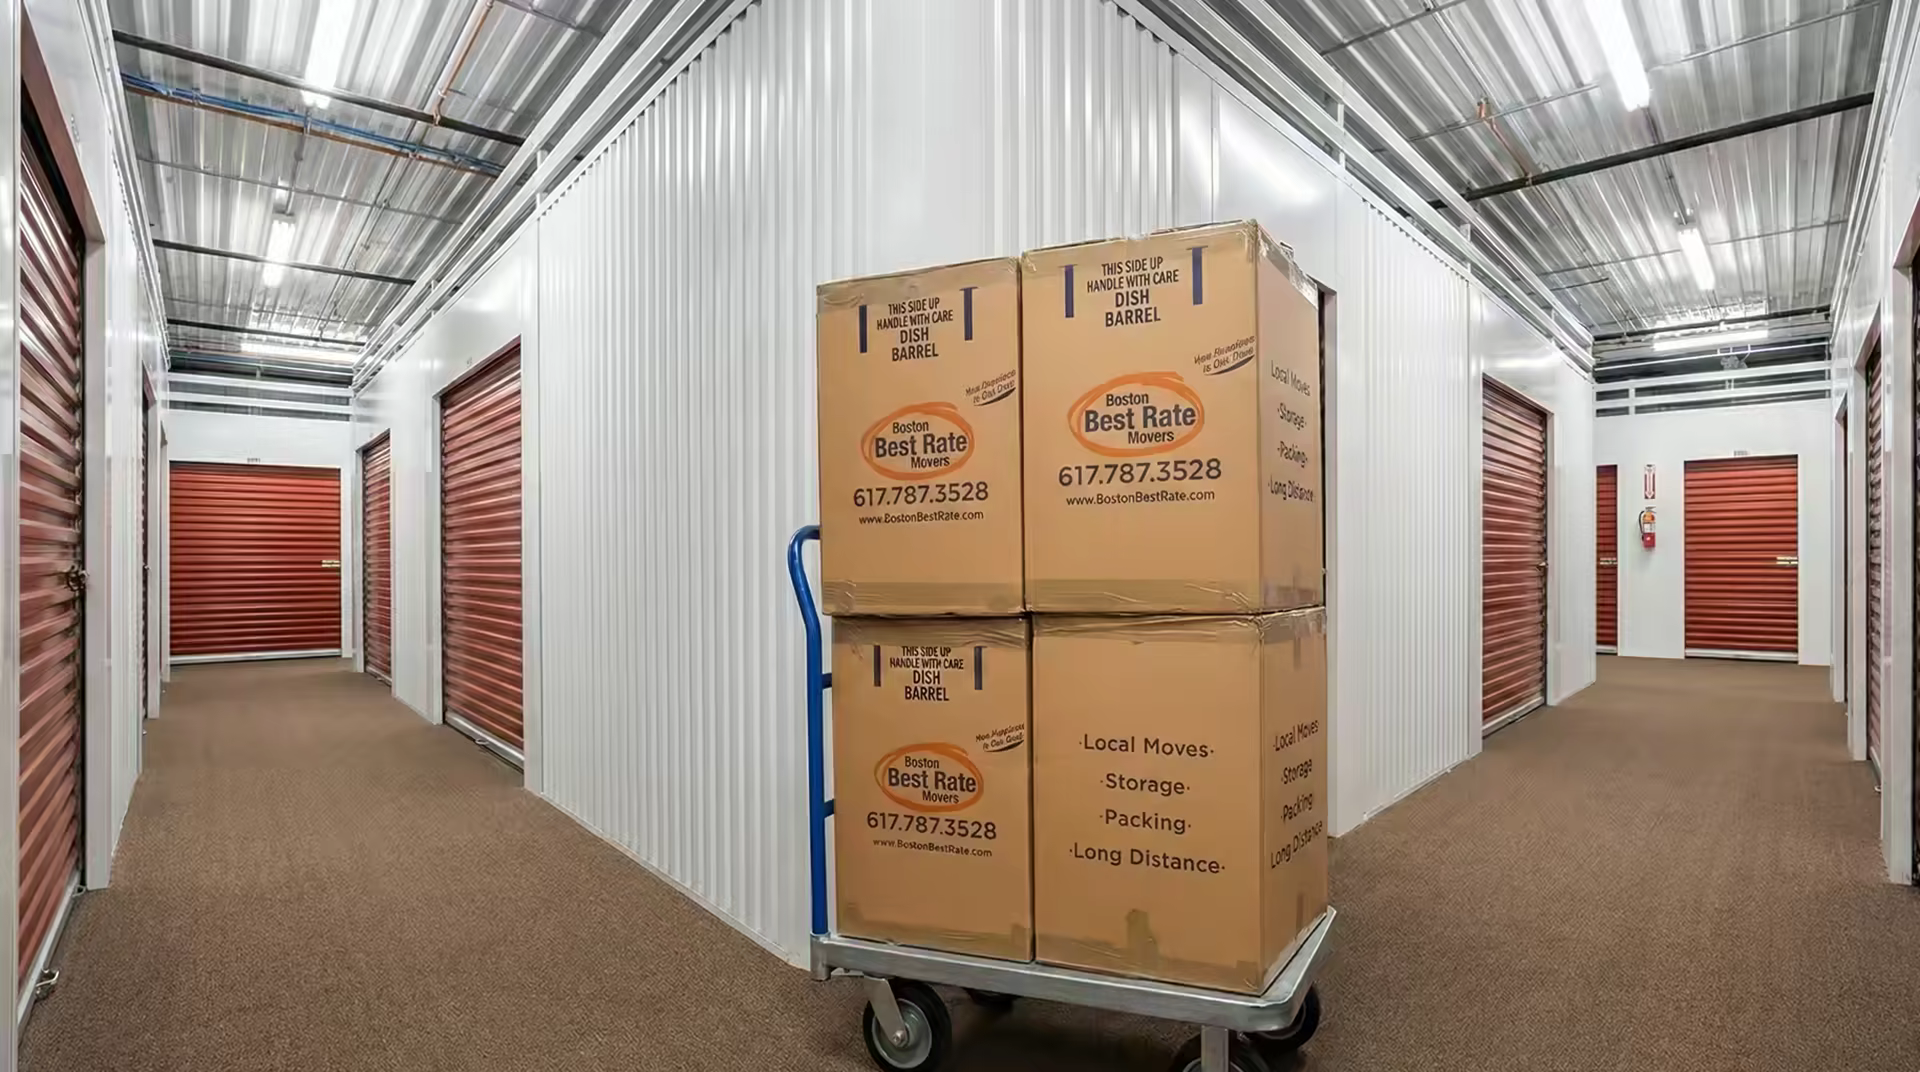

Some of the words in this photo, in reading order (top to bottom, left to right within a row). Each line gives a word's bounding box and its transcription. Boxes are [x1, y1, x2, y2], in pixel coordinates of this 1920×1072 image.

[1101, 261, 1123, 276] THIS
[1125, 258, 1148, 274] SIDE
[1150, 256, 1164, 270] UP
[1087, 277, 1124, 293] HANDLE
[1126, 273, 1150, 288] WITH
[1152, 269, 1179, 285] CARE
[888, 302, 906, 316] THIS
[908, 299, 927, 313] SIDE
[929, 297, 940, 310] UP
[1115, 289, 1150, 308] DISH
[876, 316, 909, 331] HANDLE
[910, 313, 930, 327] WITH
[932, 309, 954, 323] CARE
[1105, 306, 1161, 327] BARREL
[900, 327, 929, 344] DISH
[892, 343, 939, 362] BARREL
[1106, 392, 1149, 407] Boston
[893, 421, 929, 434] Boston
[1084, 408, 1135, 433] Best
[1142, 404, 1196, 429] Rate
[875, 436, 917, 458] Best
[923, 432, 968, 454] Rate
[1128, 430, 1175, 444] Movers
[911, 456, 950, 469] Movers
[1058, 458, 1222, 487] 617.787.3528
[853, 481, 989, 507] 617.787.3528
[1066, 490, 1215, 506] www.BostonBestRate.com
[902, 646, 919, 657] THIS
[920, 646, 938, 657] SIDE
[940, 646, 952, 657] UP
[890, 657, 920, 669] HANDLE
[921, 658, 941, 669] WITH
[943, 659, 964, 669] CARE
[913, 670, 941, 685] DISH
[904, 686, 950, 701] BARREL
[904, 756, 939, 769] Boston
[888, 767, 929, 789] Best
[934, 771, 977, 793] Rate
[922, 790, 960, 804] Movers
[867, 811, 997, 841] 617.787.3528
[873, 839, 993, 858] www.BostonBestRate.com
